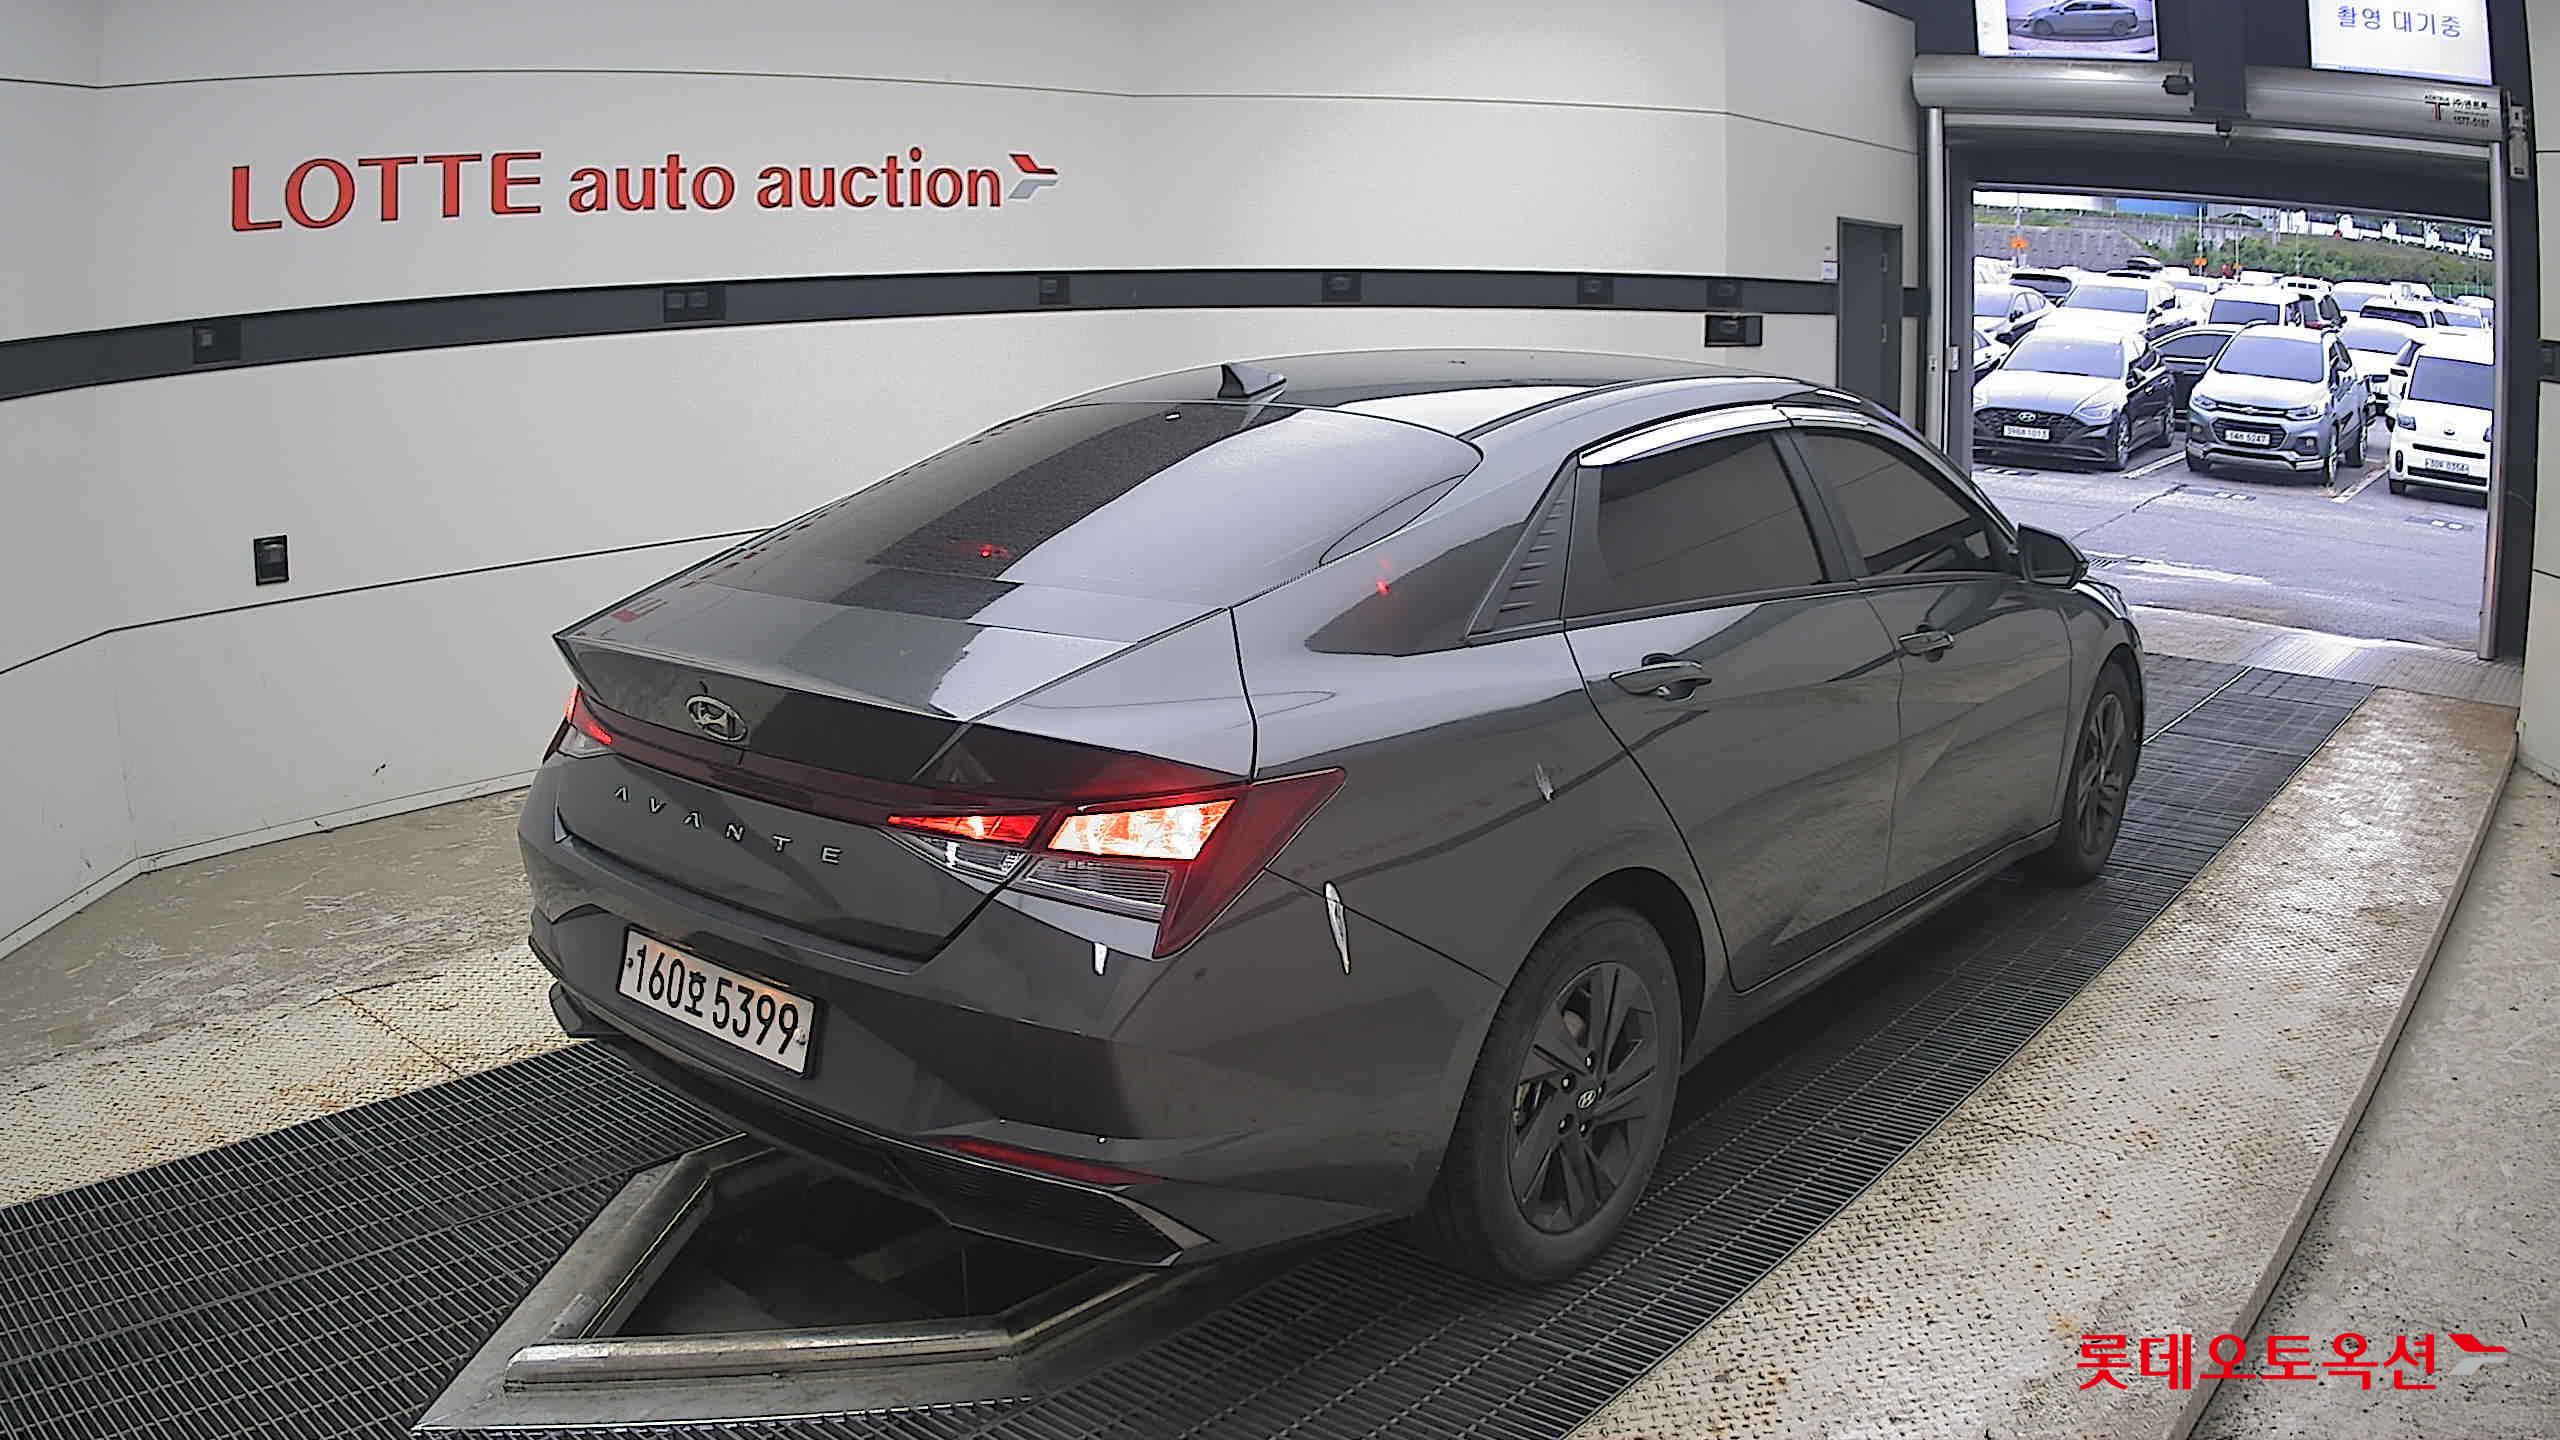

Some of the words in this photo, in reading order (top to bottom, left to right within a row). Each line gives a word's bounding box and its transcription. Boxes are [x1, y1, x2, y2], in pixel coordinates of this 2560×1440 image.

[2337, 5, 2382, 30] 촬영
[2393, 11, 2462, 38] 대기중
[231, 152, 543, 232] LOTTE
[568, 154, 736, 214] auto
[757, 147, 1003, 210] auction
[614, 784, 843, 865] AVANTE
[637, 944, 707, 1018] 160호
[712, 976, 800, 1055] 5399
